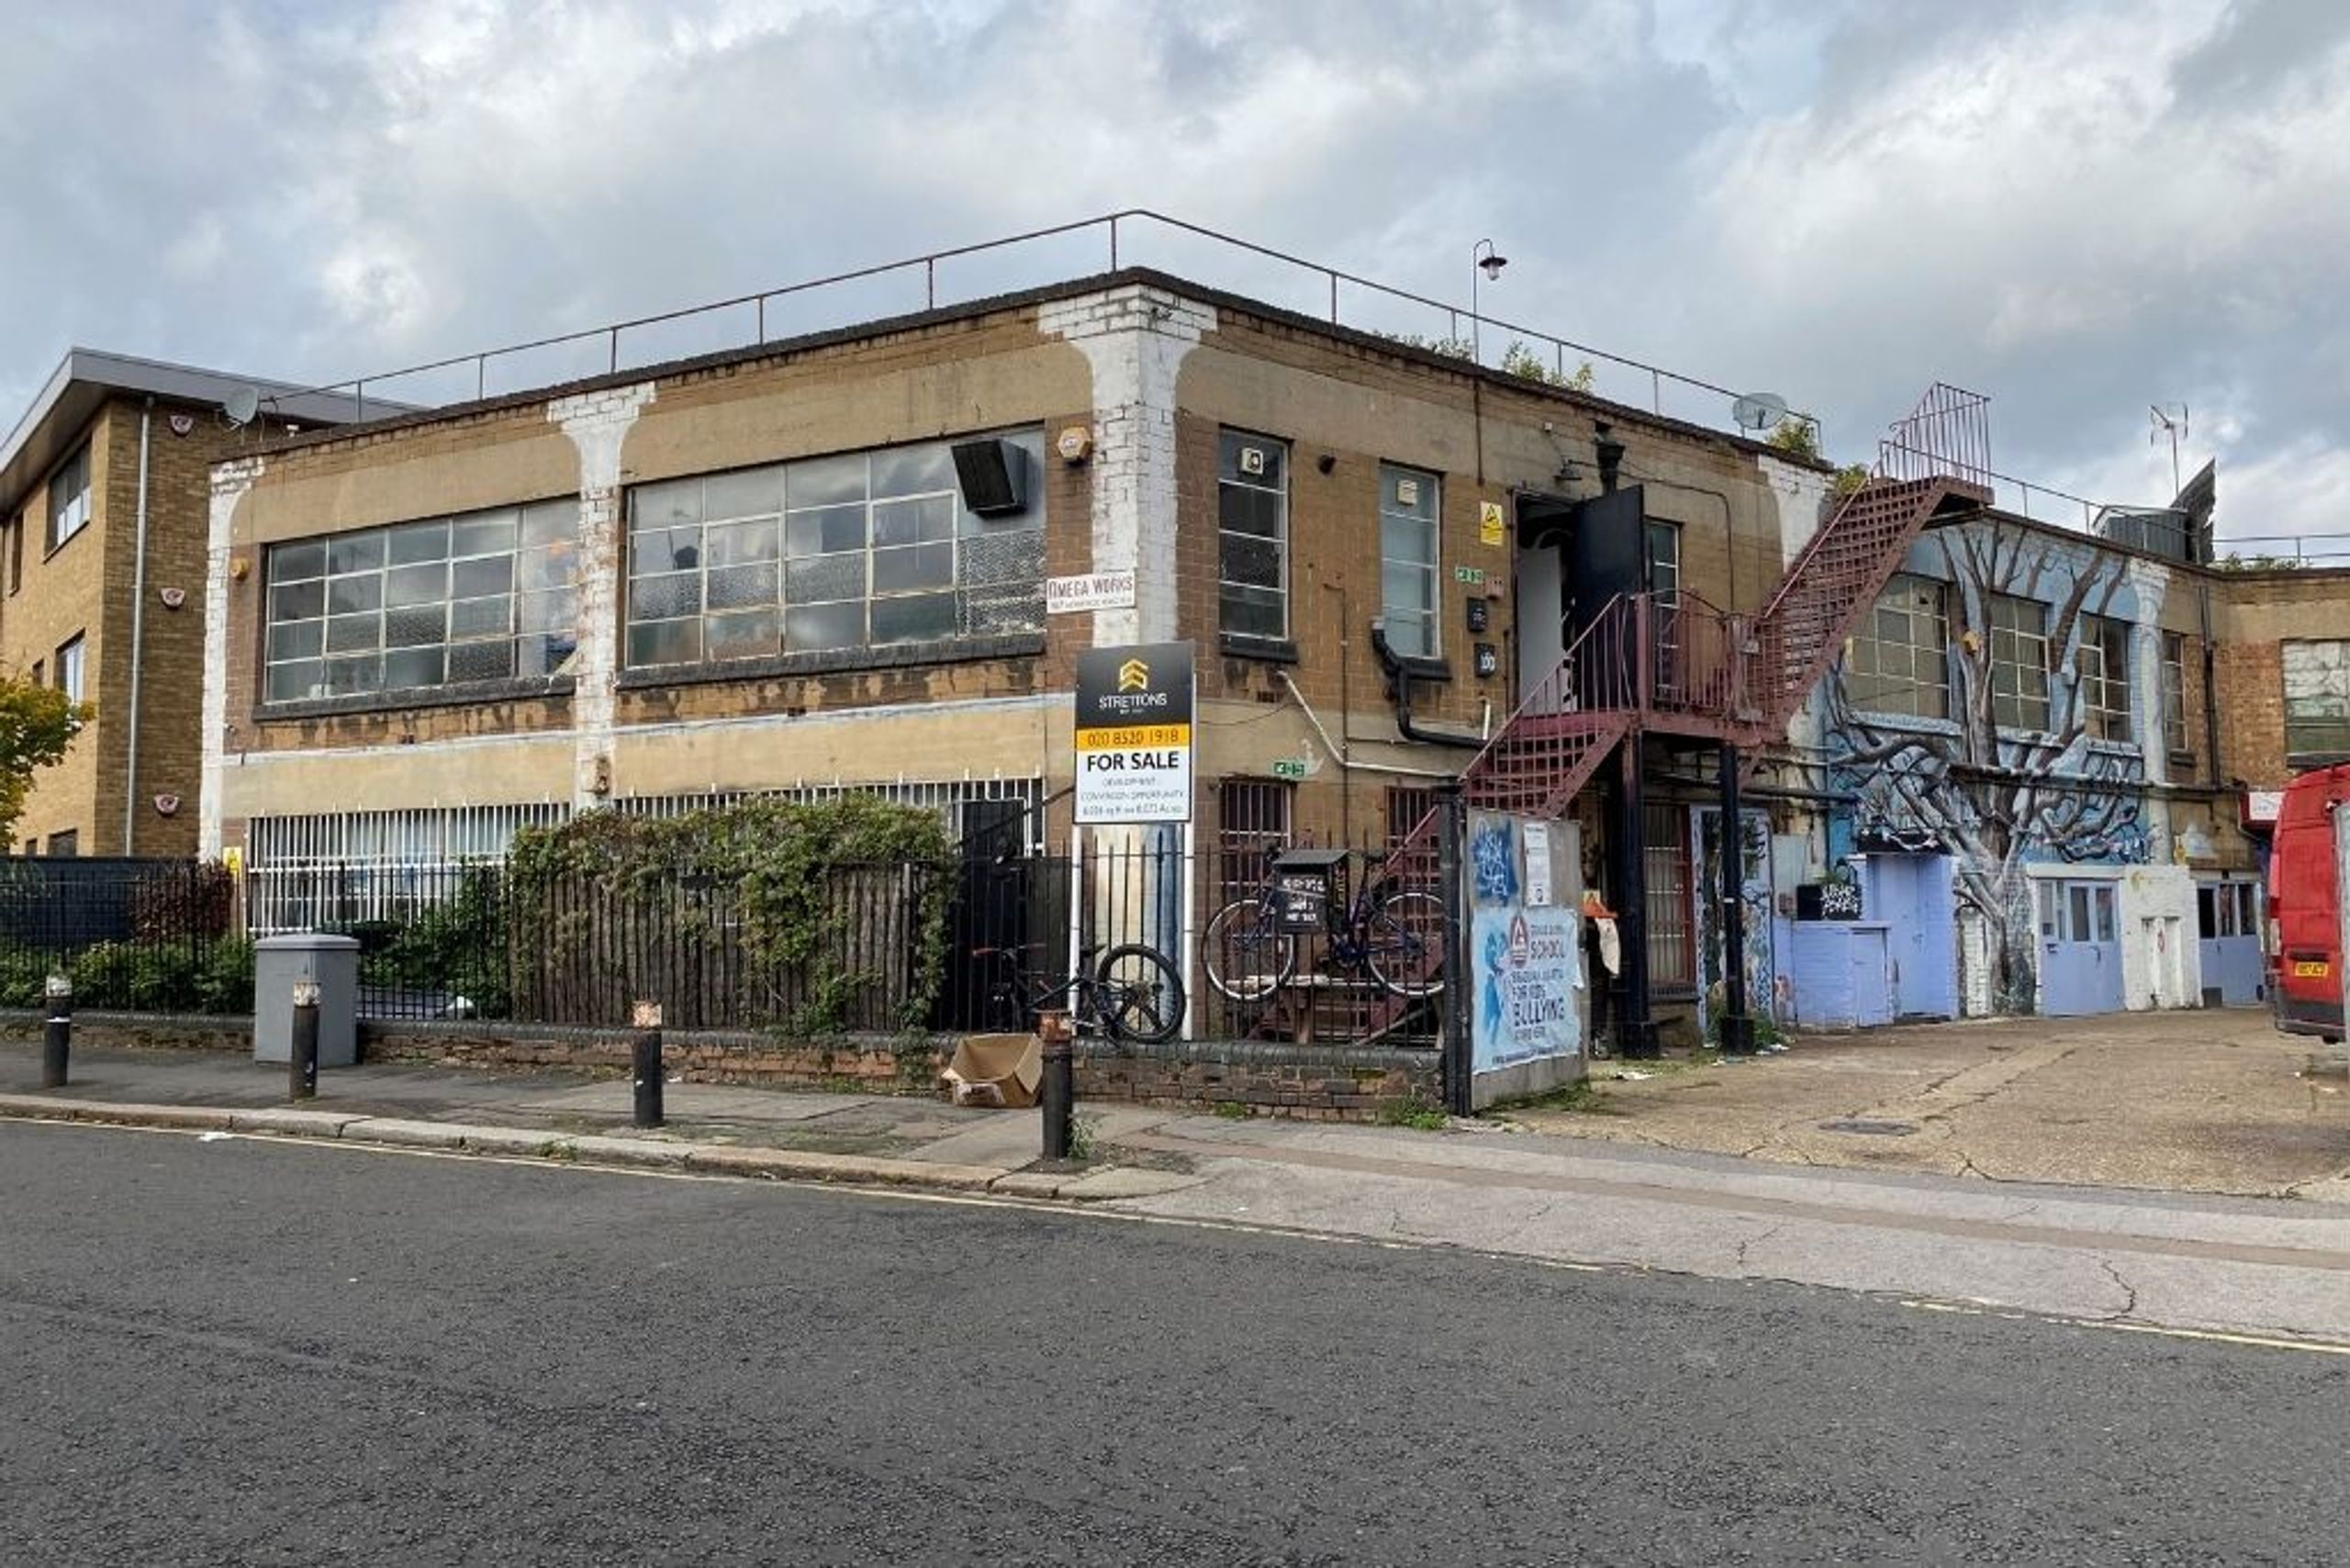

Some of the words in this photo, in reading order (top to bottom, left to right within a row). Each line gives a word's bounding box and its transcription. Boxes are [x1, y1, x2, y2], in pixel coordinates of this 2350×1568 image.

[1092, 576, 1133, 595] WORKS
[1099, 693, 1168, 710] STRETTONS
[1087, 732, 1109, 746] 020
[1113, 730, 1144, 745] 8520
[1149, 728, 1179, 743] 1918
[1087, 753, 1125, 772] FOR
[1131, 751, 1179, 770] SALE
[1514, 996, 1564, 1026] BULLYING
